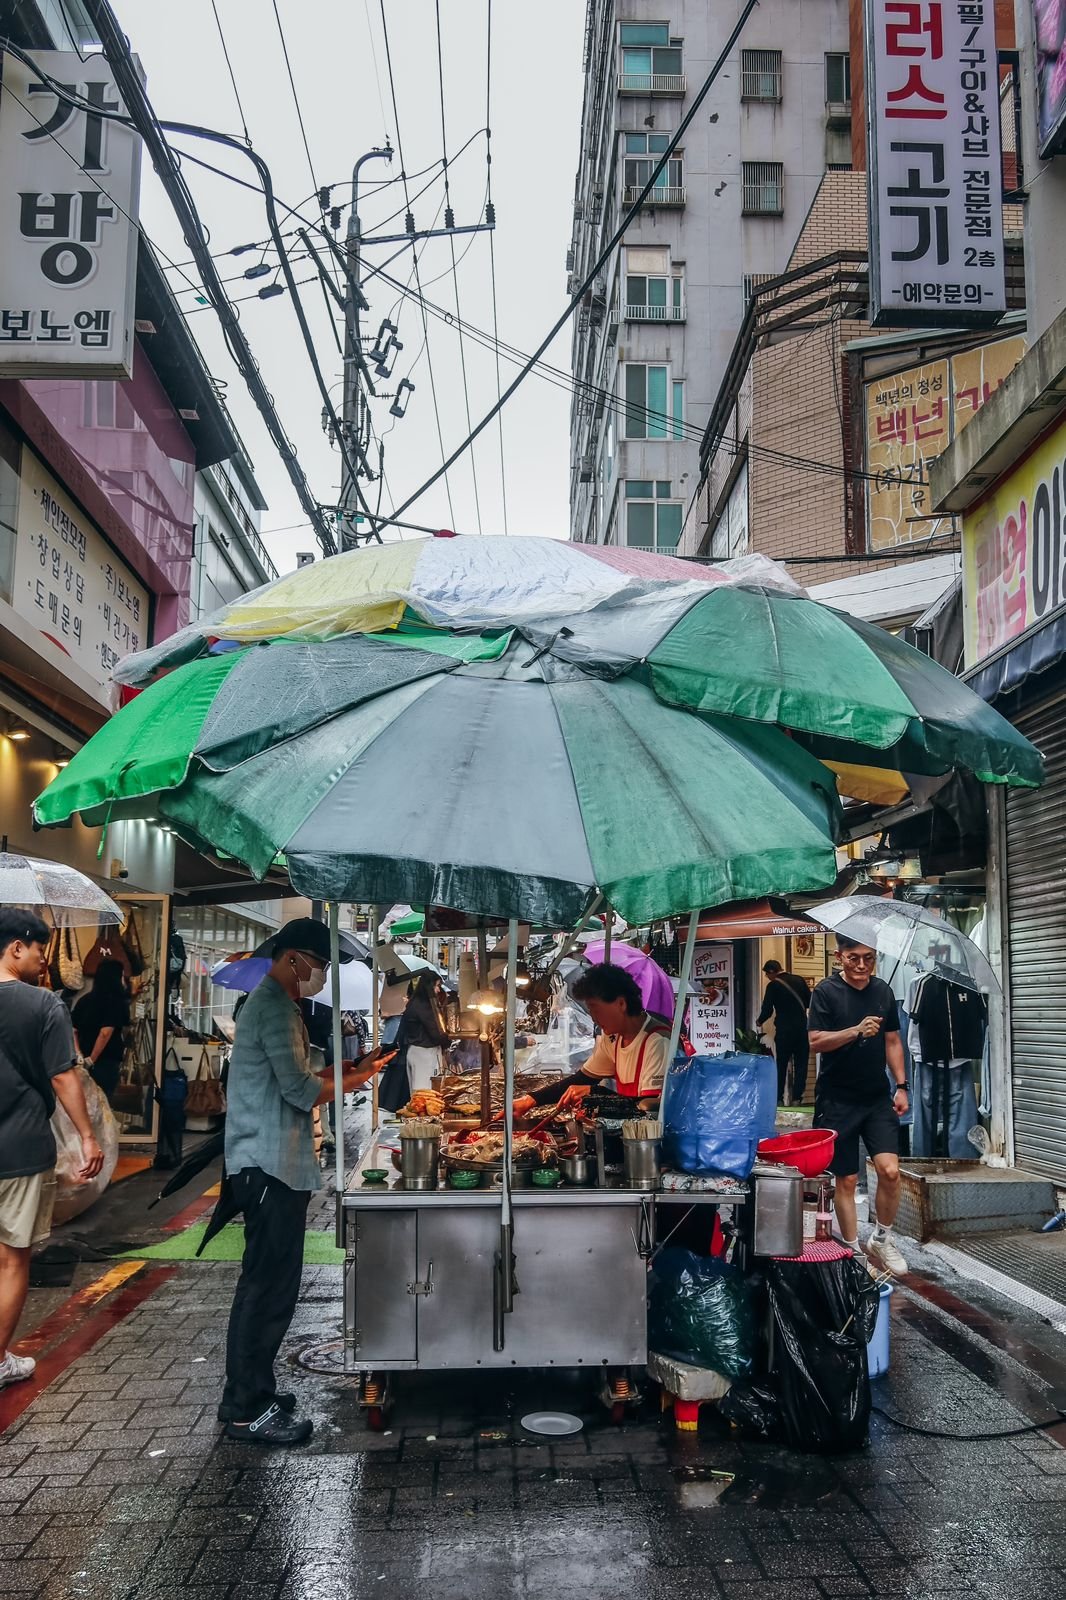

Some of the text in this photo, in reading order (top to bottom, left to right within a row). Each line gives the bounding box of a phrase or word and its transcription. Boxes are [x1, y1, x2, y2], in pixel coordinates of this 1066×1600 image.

[17, 81, 119, 285] 가방
[887, 141, 950, 266] 고기
[962, 170, 992, 237] 전문점
[963, 247, 996, 268] 2층
[0, 309, 111, 347] 보노엠
[875, 383, 913, 406] 백년의
[917, 374, 943, 396] 정성
[876, 396, 944, 446] 백년
[40, 487, 87, 562] 체인점모집
[37, 533, 85, 604] 창업상담
[34, 578, 83, 646] 도매문의
[772, 926, 795, 935] Walnut
[797, 924, 818, 933] cakes
[694, 951, 713, 967] OPEN
[695, 960, 728, 977] EVENT
[697, 1008, 728, 1019] 호두과자
